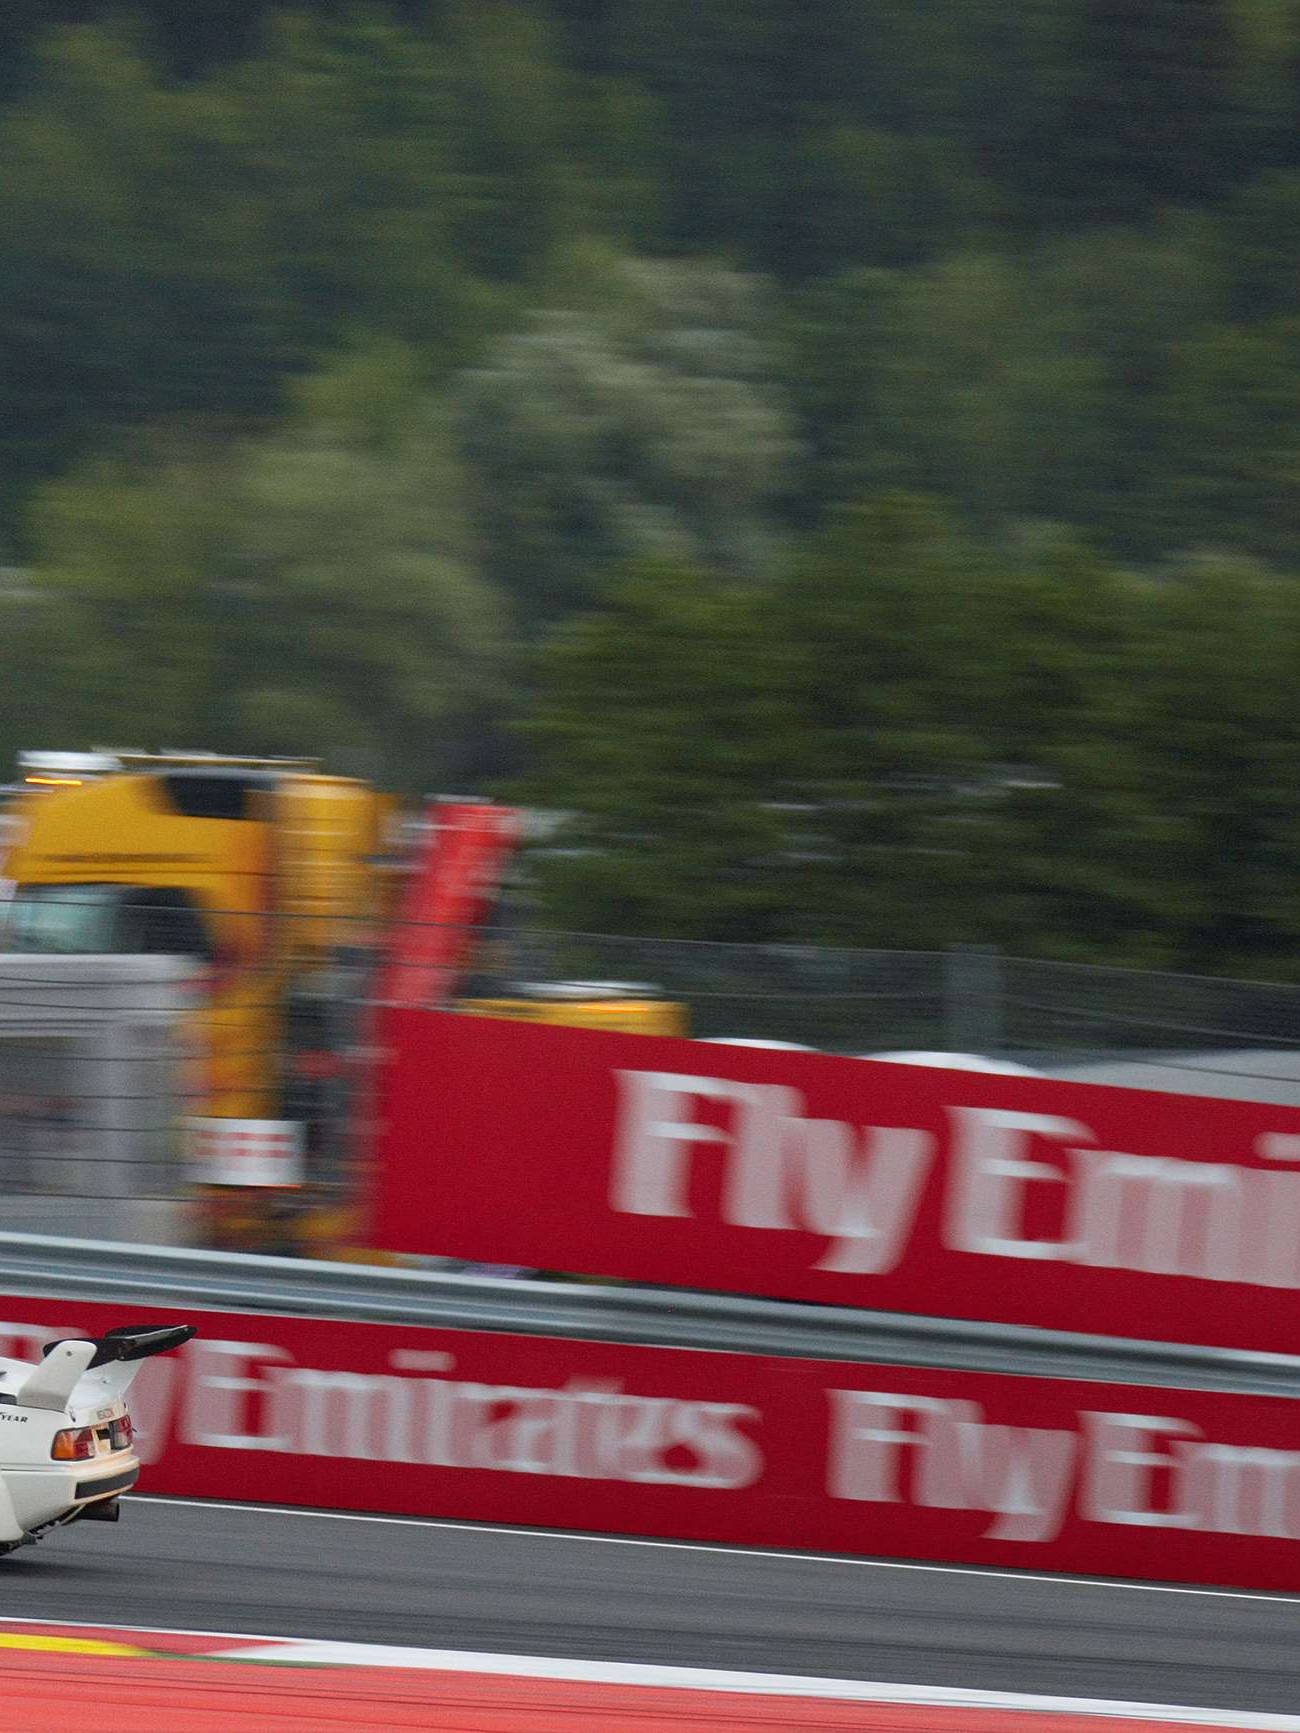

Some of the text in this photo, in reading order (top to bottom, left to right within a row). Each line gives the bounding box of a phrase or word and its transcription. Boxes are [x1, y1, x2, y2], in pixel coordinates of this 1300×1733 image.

[609, 1068, 939, 1275] Fly
[179, 1339, 764, 1490] Emirates
[827, 1388, 1079, 1543] Fly
